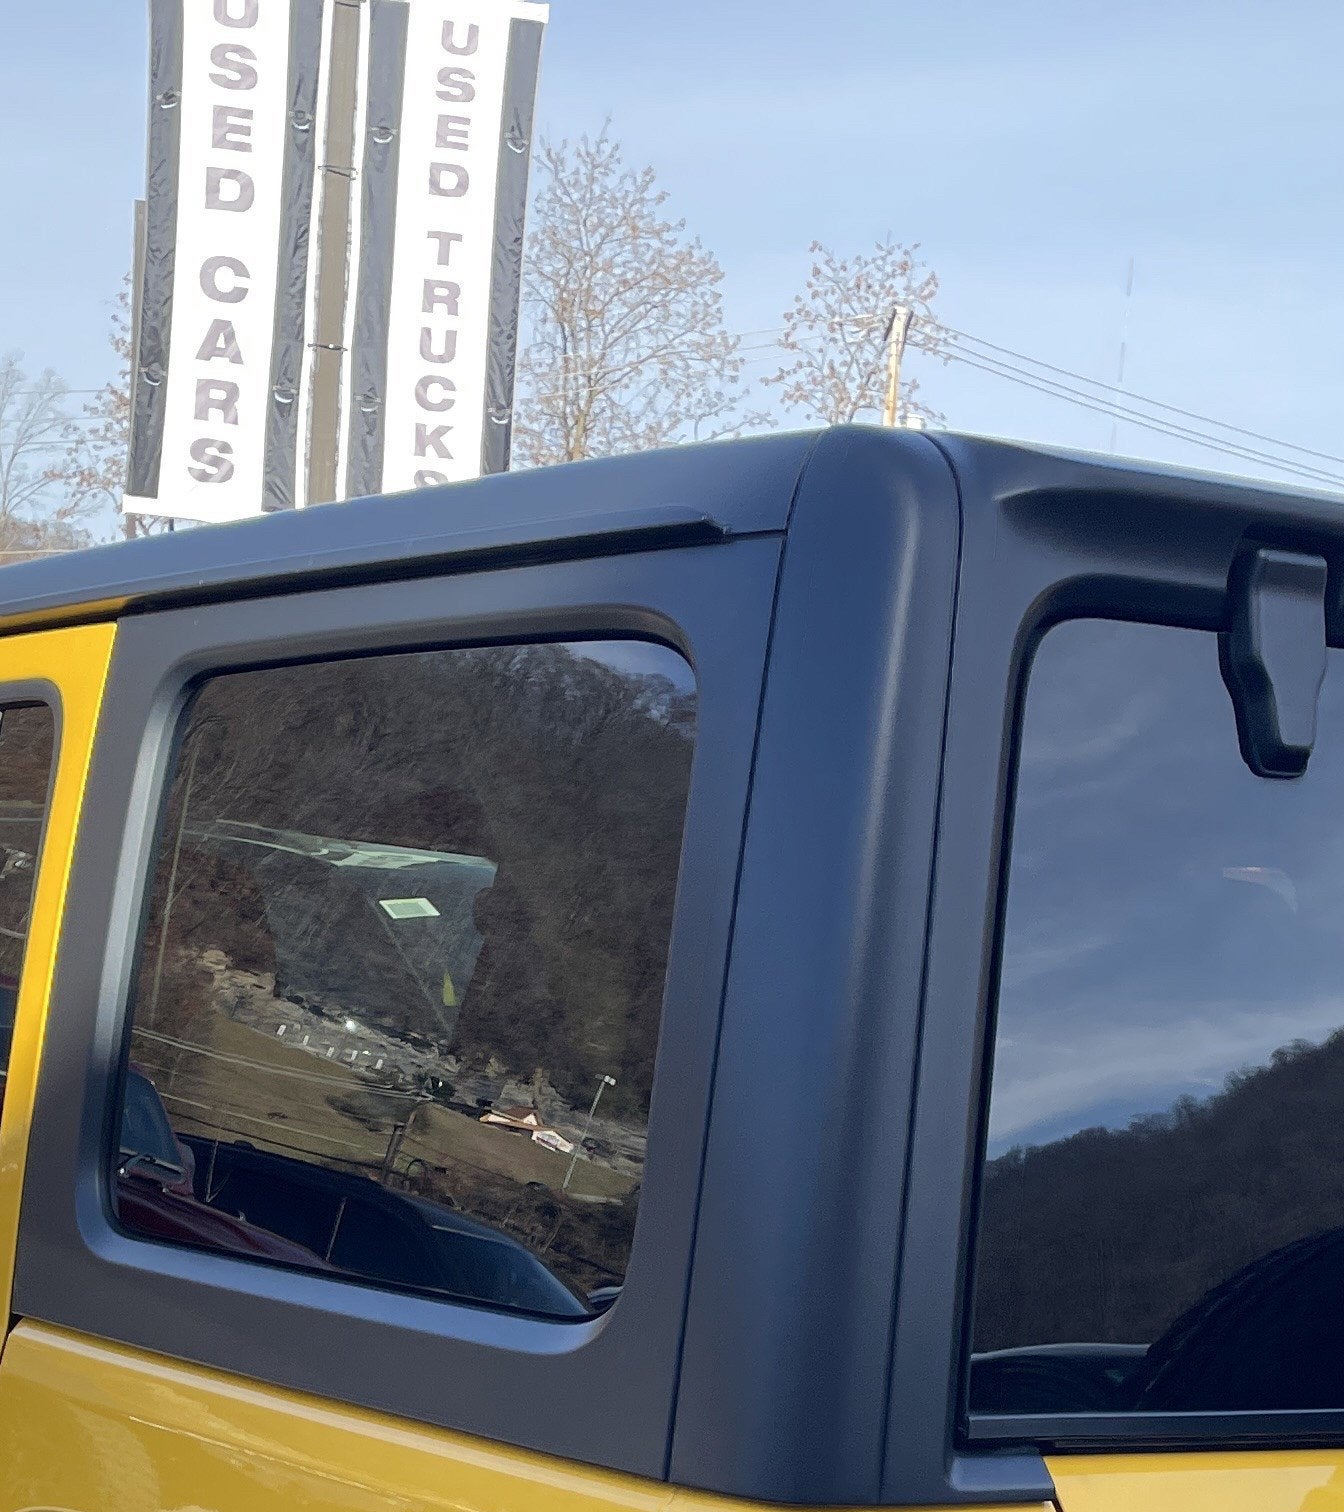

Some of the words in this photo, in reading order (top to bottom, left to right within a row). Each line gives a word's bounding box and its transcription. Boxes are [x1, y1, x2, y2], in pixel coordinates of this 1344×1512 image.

[204, 0, 259, 213] USED
[427, 19, 480, 198] USED
[187, 254, 252, 485] CARS
